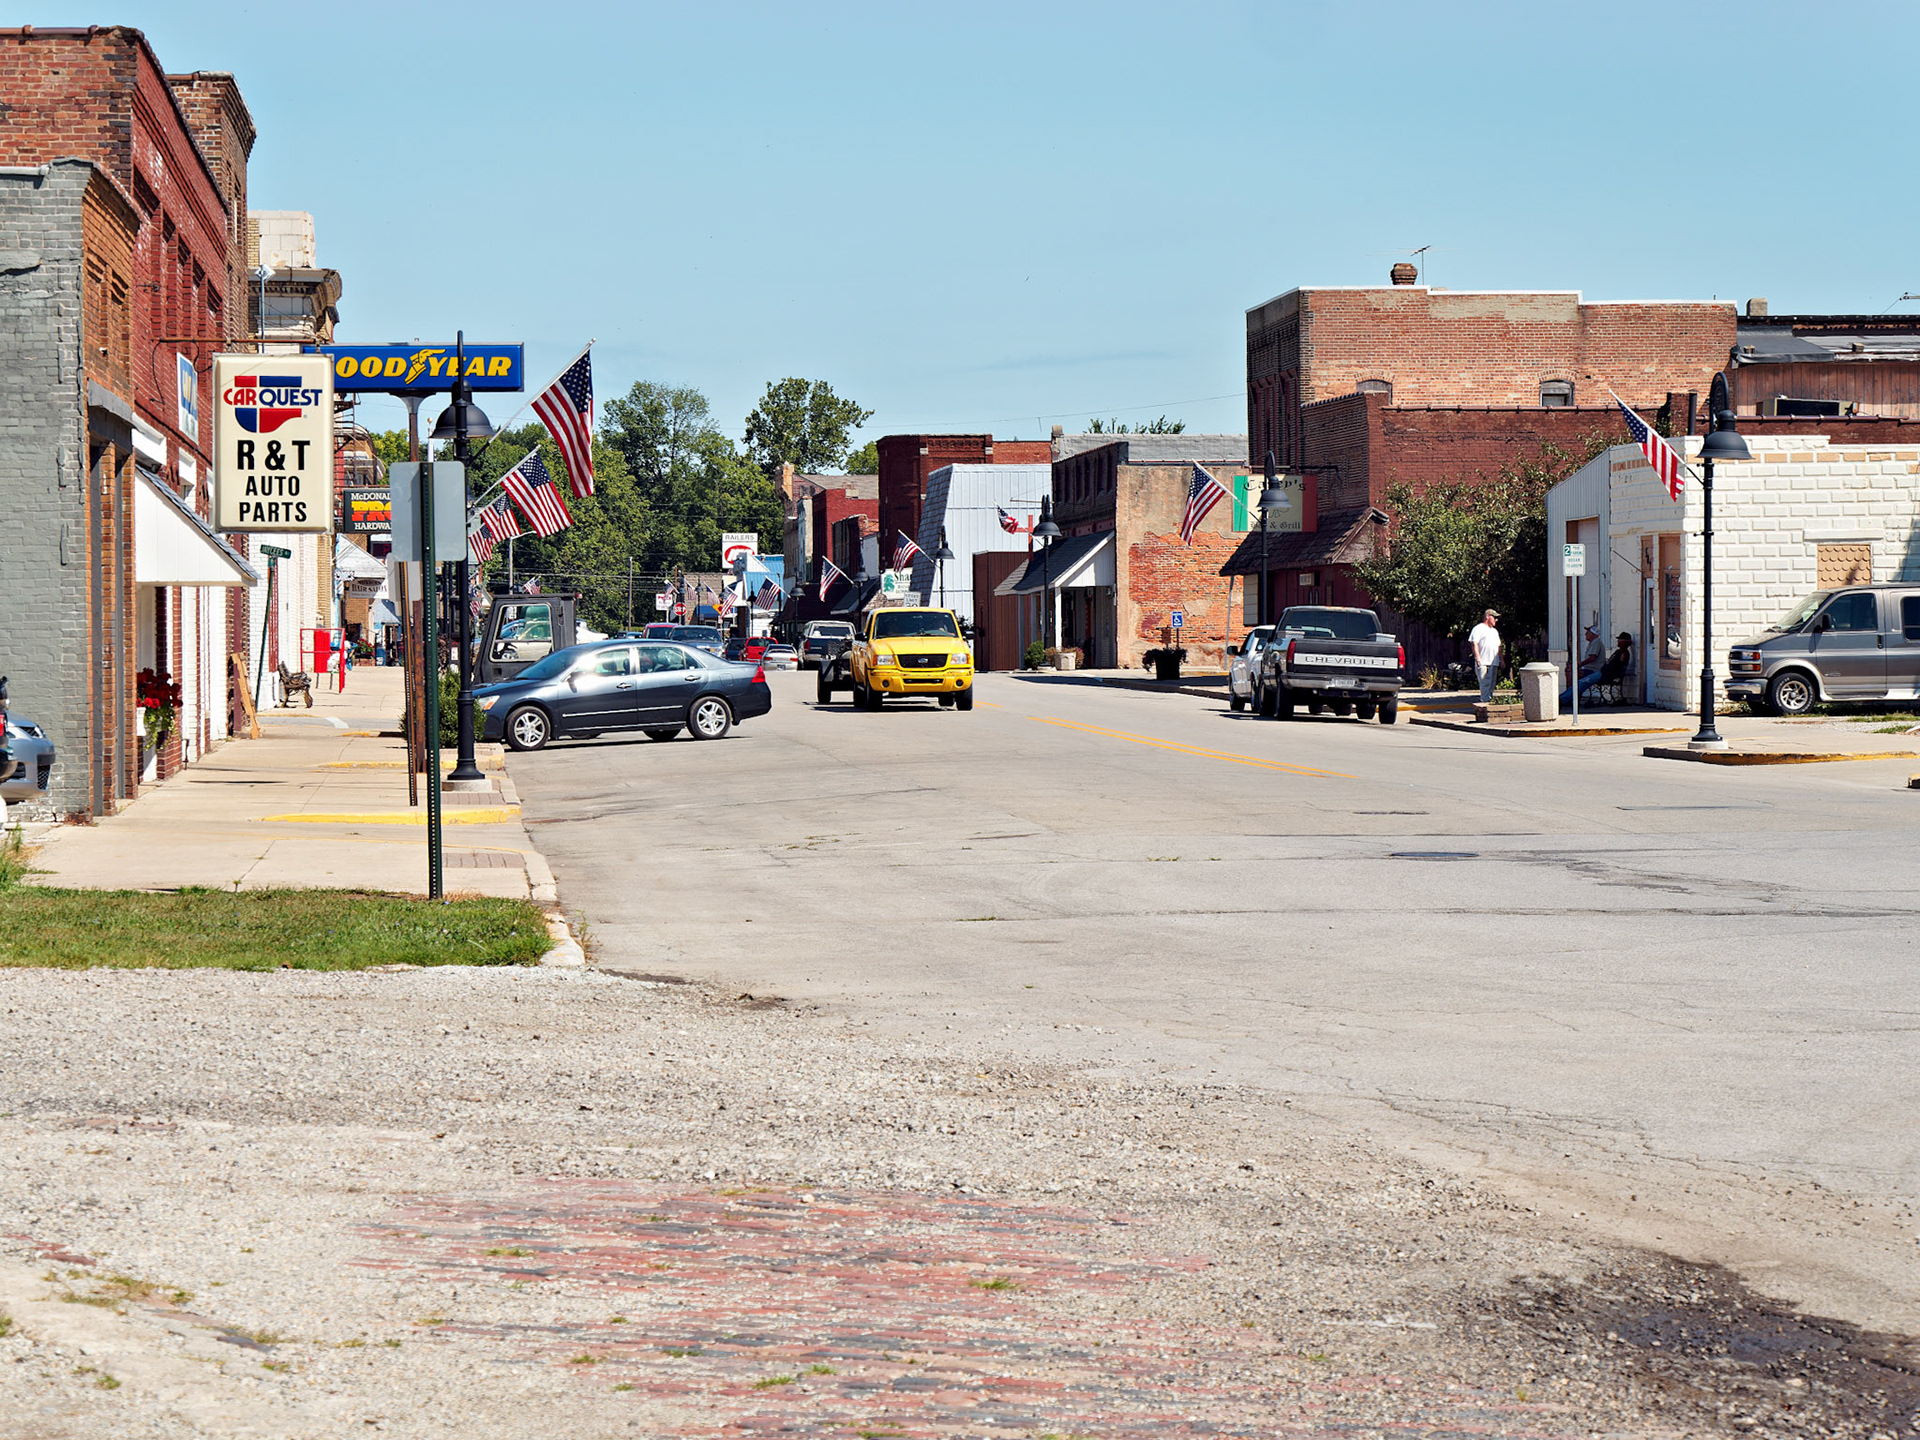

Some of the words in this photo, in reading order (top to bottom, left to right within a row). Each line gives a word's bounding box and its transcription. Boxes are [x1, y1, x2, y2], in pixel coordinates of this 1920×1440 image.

[335, 356, 512, 378] OODYEAR
[223, 388, 323, 407] CARQUEST
[237, 439, 255, 470] R
[264, 439, 286, 470] &
[291, 440, 311, 470] T
[245, 475, 300, 496] AUTO
[239, 501, 307, 522] PARTS
[354, 522, 392, 530] HARDWA
[1269, 521, 1277, 530] &
[1279, 521, 1301, 530] Grill
[1305, 655, 1388, 667] CHEVROLET
